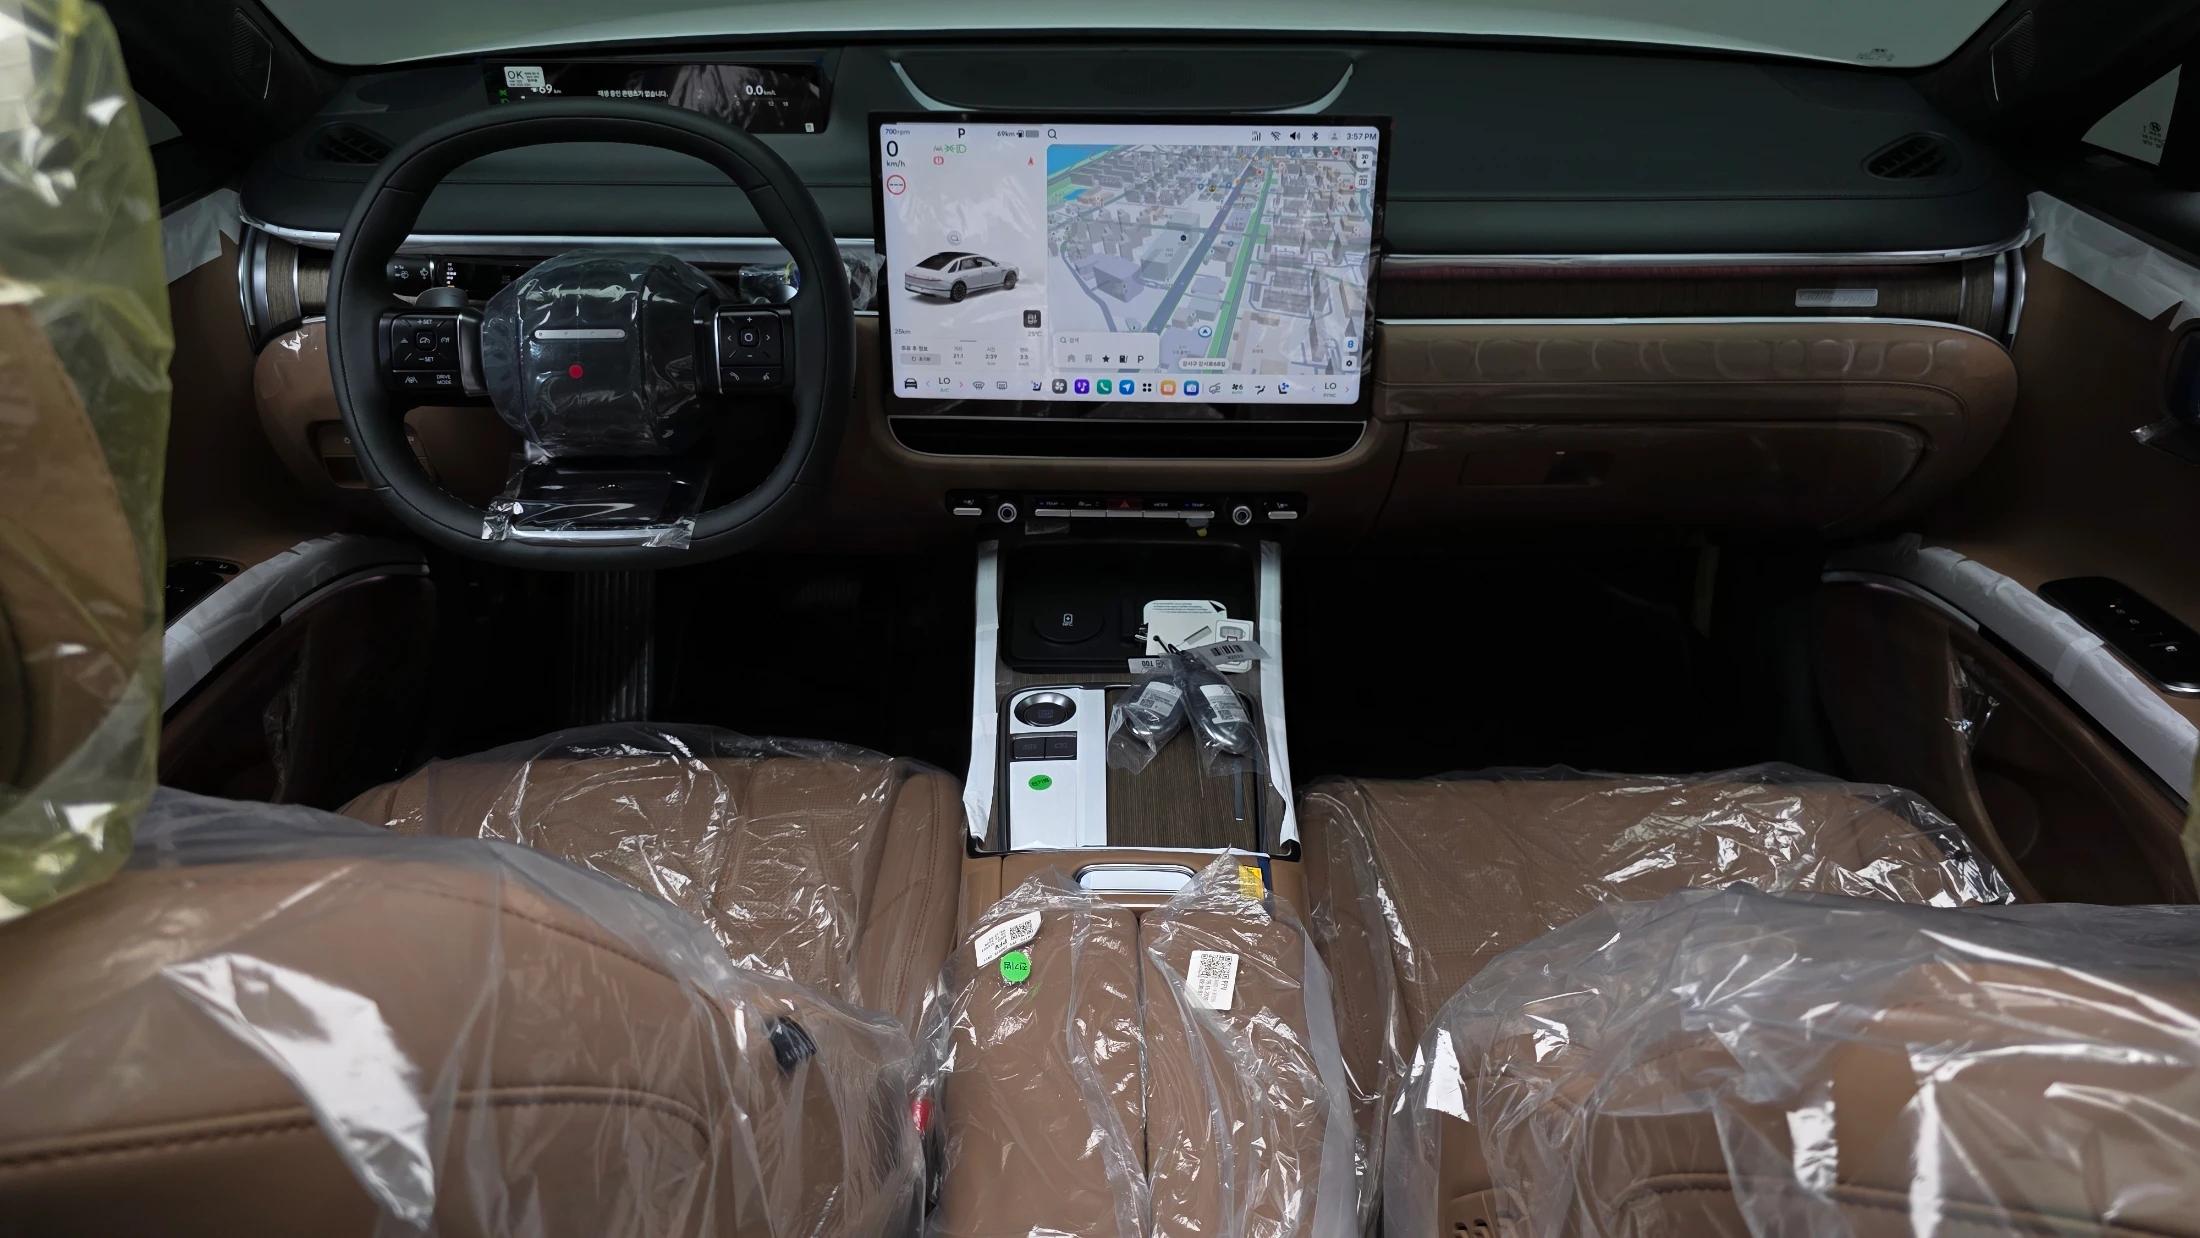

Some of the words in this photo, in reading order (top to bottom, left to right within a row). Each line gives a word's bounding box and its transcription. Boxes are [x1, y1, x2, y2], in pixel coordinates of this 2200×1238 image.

[508, 70, 524, 80] OK
[539, 84, 553, 94] 69
[596, 89, 609, 98] 재생
[745, 84, 764, 96] 0.0
[957, 128, 966, 138] P
[997, 130, 1016, 138] 69km
[1346, 133, 1363, 141] 3:57
[1364, 133, 1377, 141] PM
[886, 140, 899, 157] 0
[886, 159, 906, 168] km/h
[894, 328, 912, 336] 25km
[1137, 355, 1144, 364] P
[938, 376, 951, 385] LO
[1324, 382, 1337, 390] LO
[1003, 961, 1028, 971] 전기범
[1220, 980, 1229, 991] PFV
